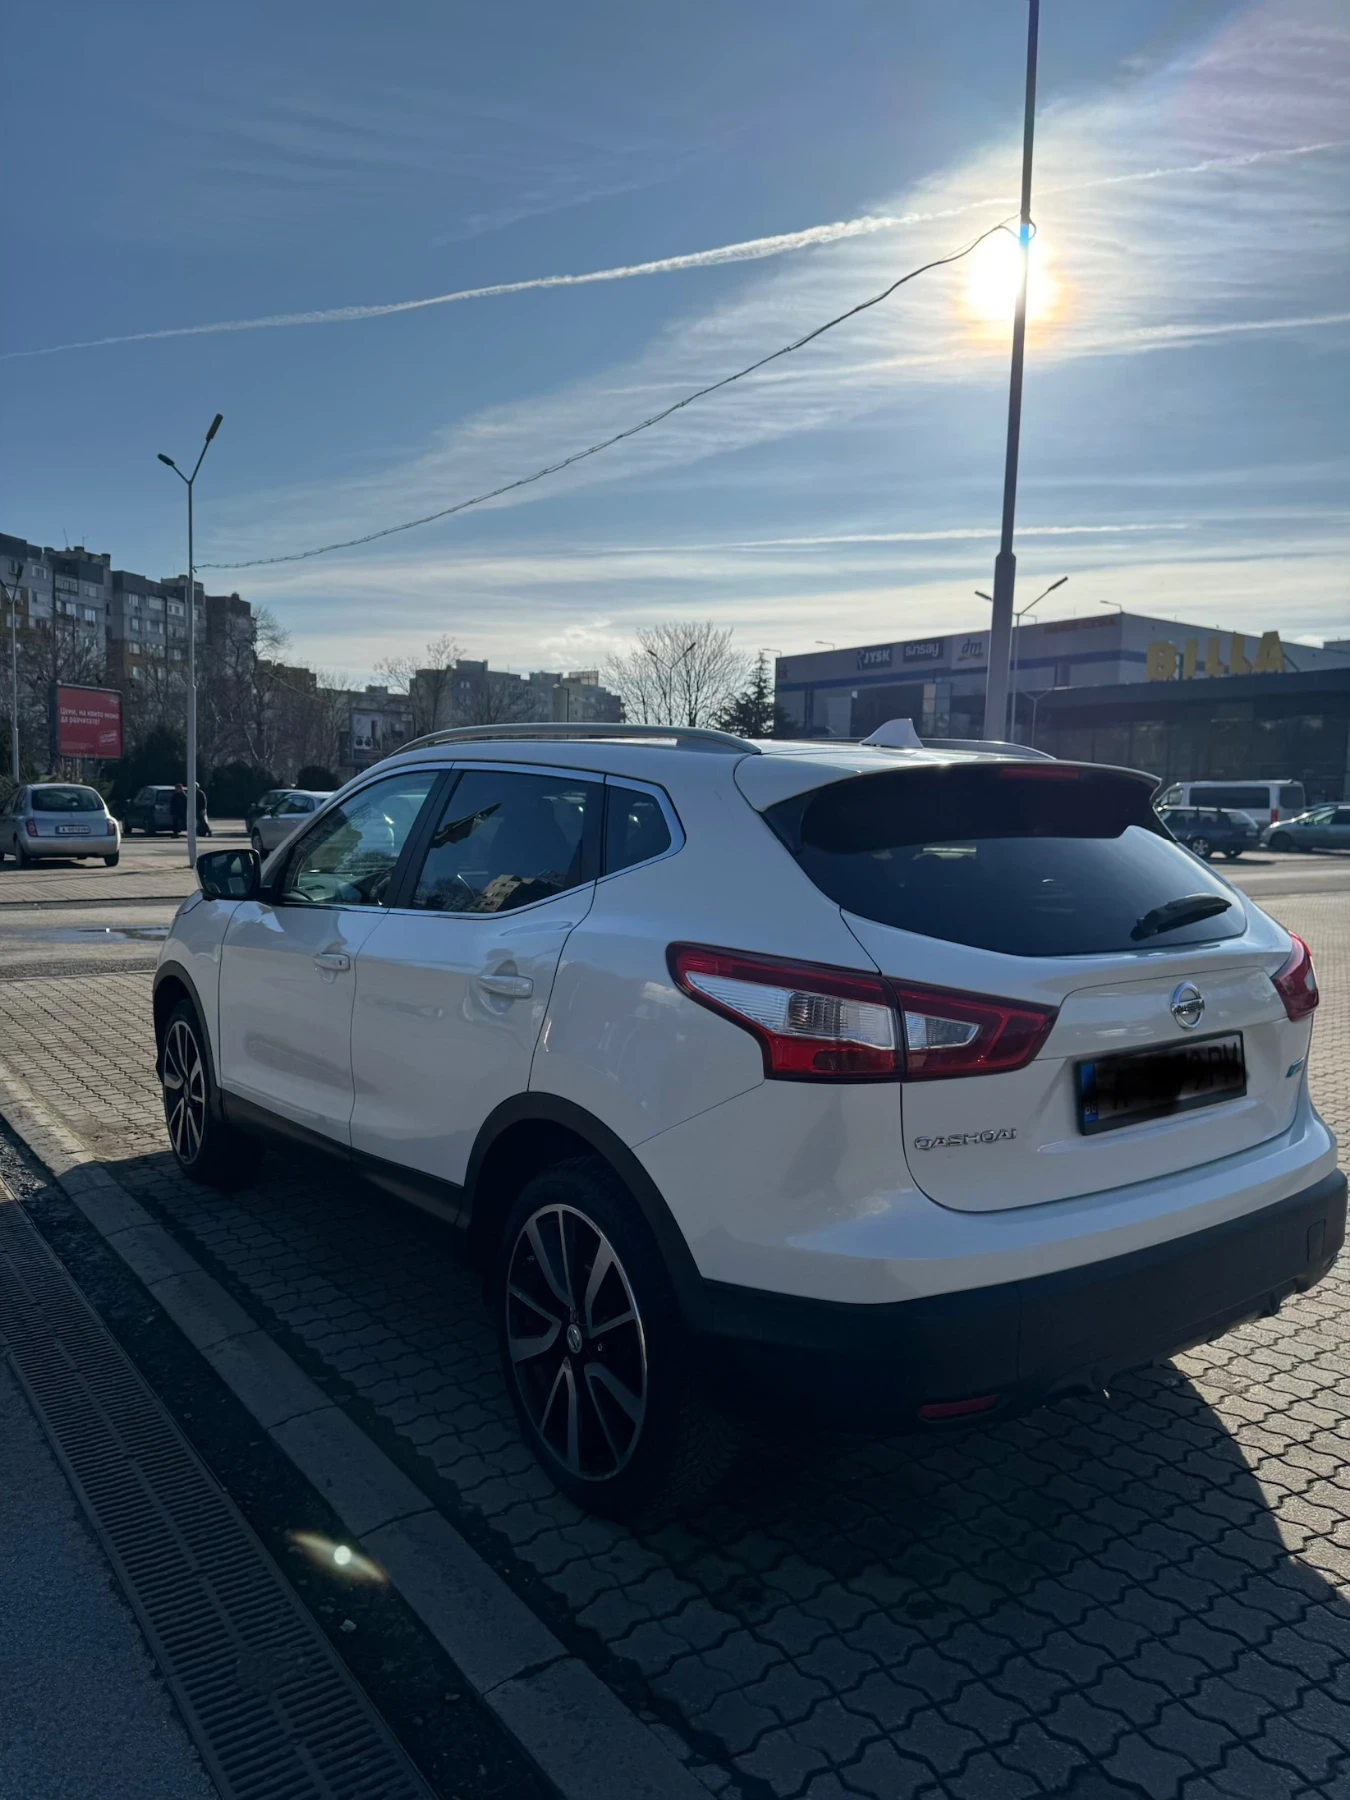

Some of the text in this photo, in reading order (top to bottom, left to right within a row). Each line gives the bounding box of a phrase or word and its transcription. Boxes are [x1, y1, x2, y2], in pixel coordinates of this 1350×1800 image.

[905, 642, 940, 657] sinsay
[961, 638, 983, 654] dm
[864, 649, 890, 664] JYSK
[1146, 631, 1286, 682] BILLA
[1084, 1101, 1097, 1115] BG
[914, 1127, 1017, 1151] QASHQAI
